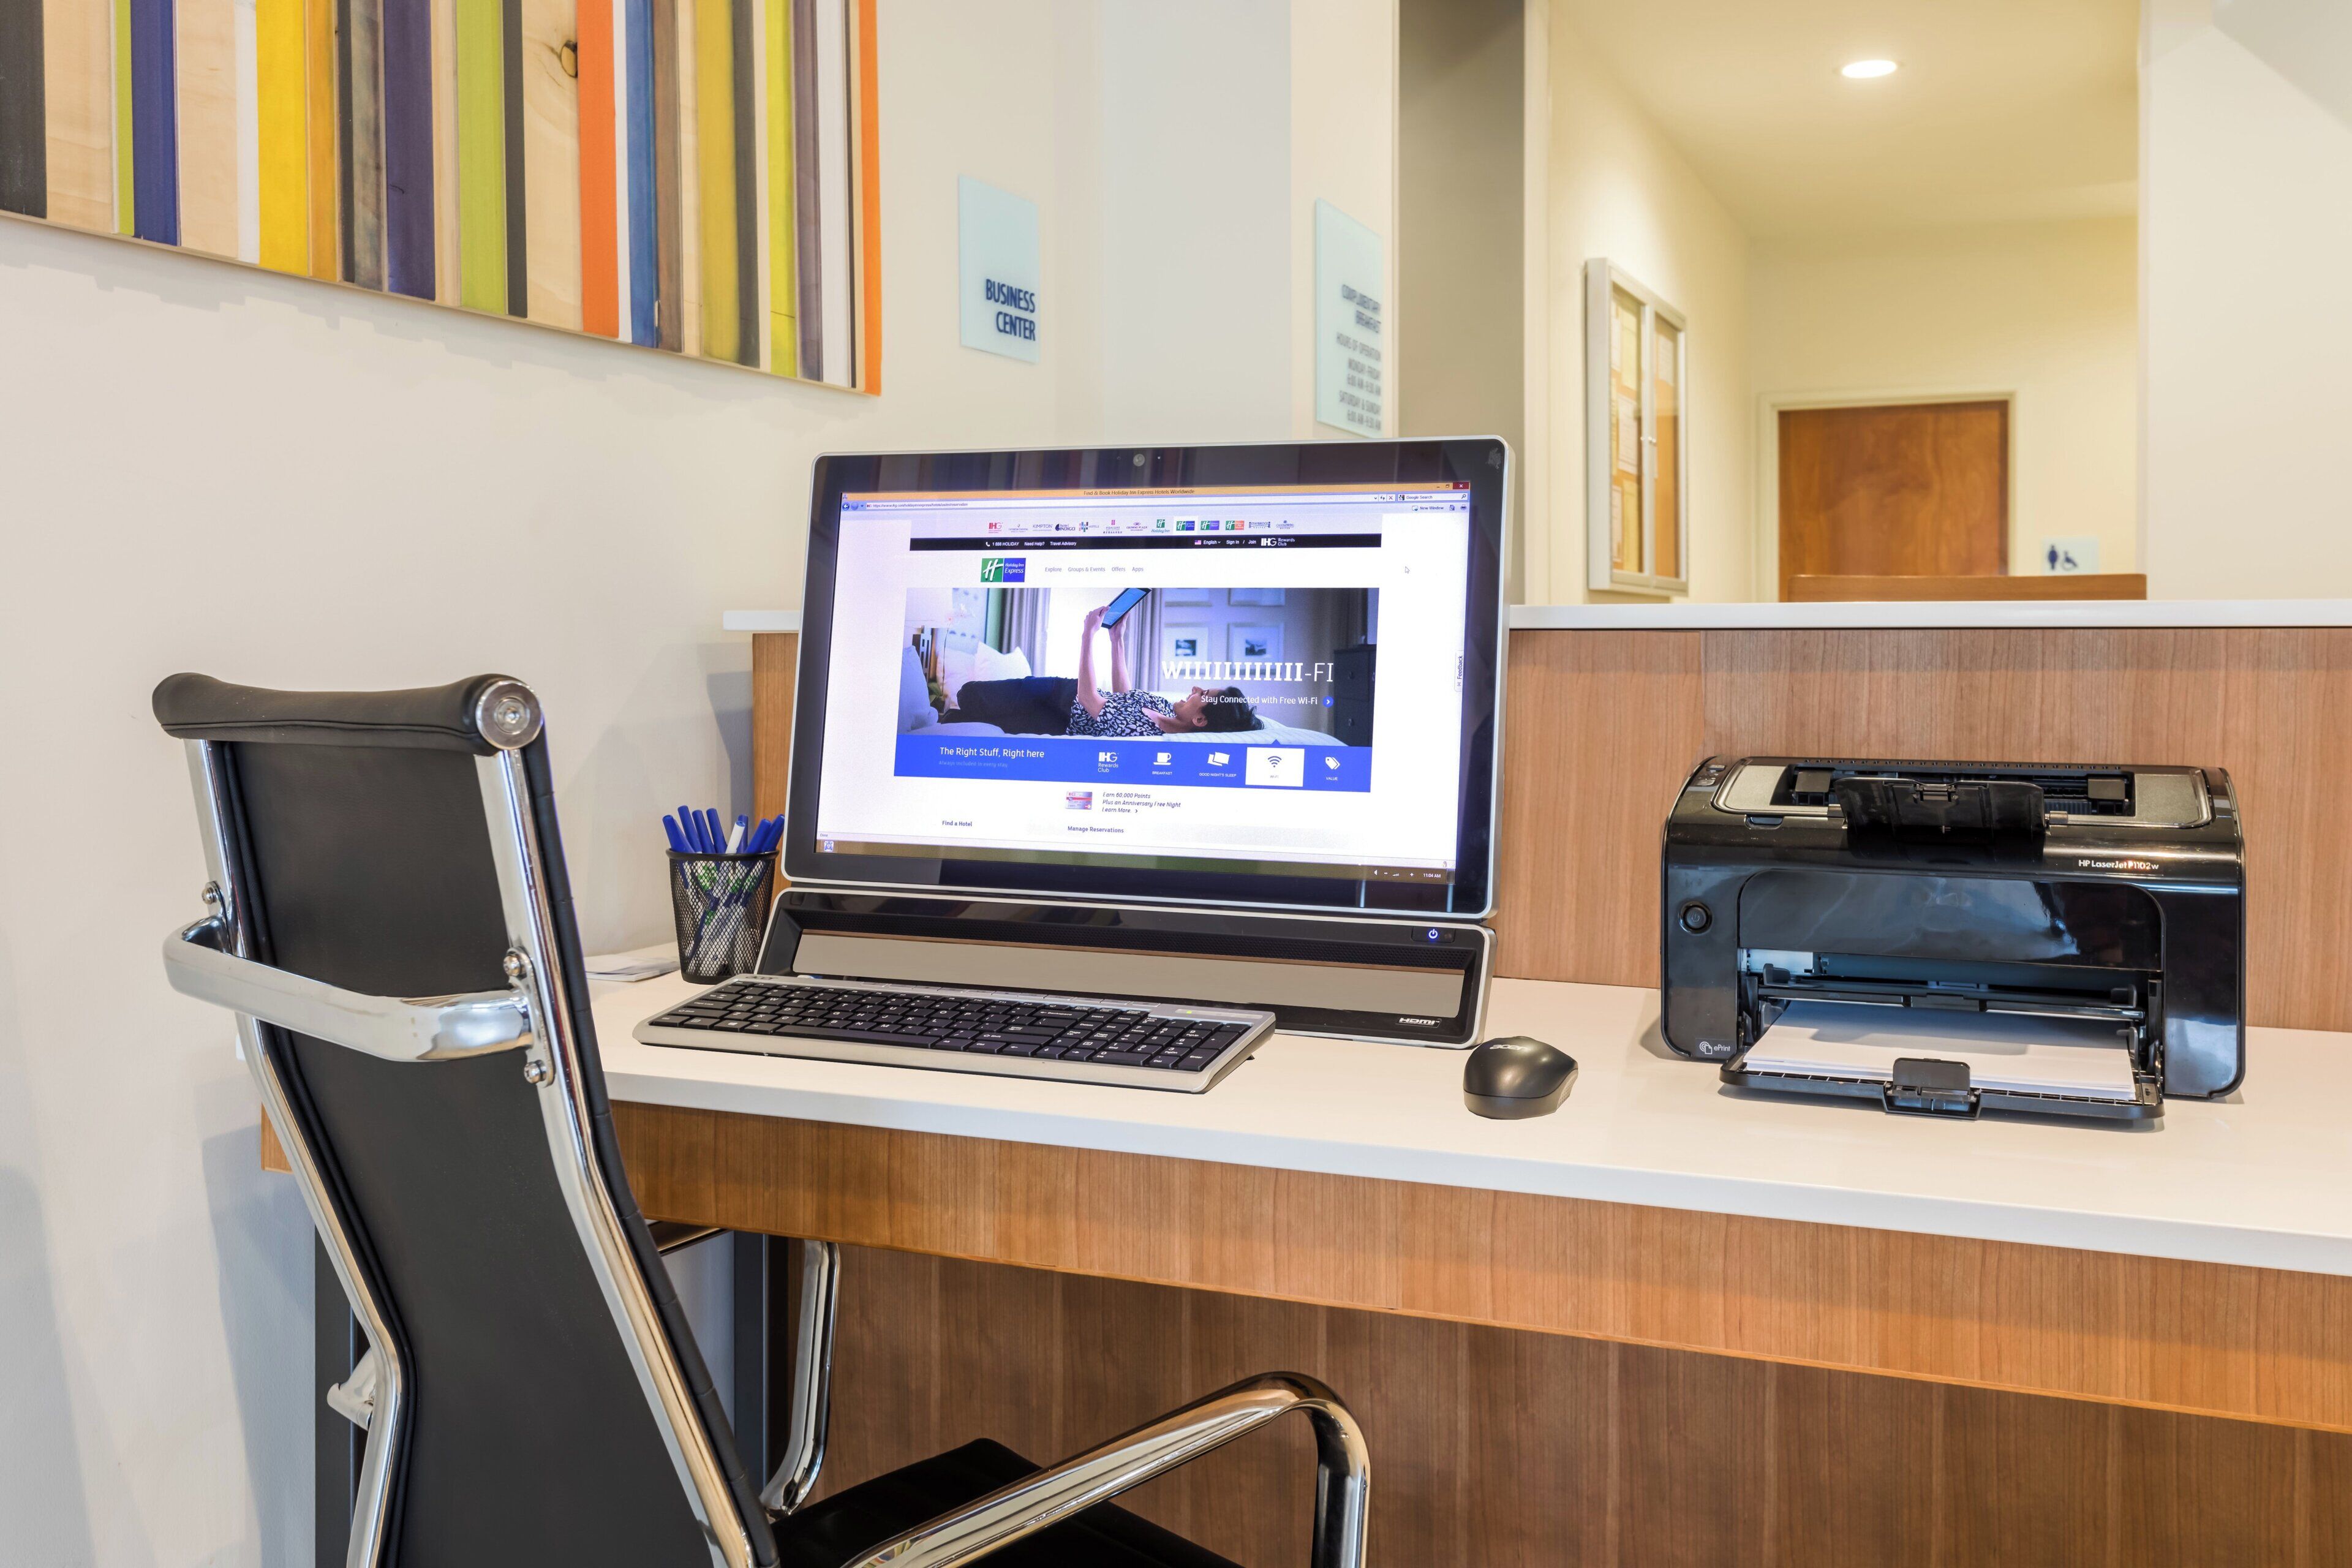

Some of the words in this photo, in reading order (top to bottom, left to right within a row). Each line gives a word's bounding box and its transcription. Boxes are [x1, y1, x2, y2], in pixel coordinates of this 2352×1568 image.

[986, 279, 1035, 314] BUSINESS
[996, 311, 1035, 341] CENTER
[1261, 538, 1277, 546] IHG
[1201, 695, 1218, 705] Stay
[1219, 696, 1261, 704] Connected
[940, 747, 954, 755] The
[956, 747, 977, 758] Right
[979, 748, 1000, 758] Stuff,
[1003, 749, 1025, 759] Right
[1098, 752, 1118, 762] IHG
[2091, 860, 2127, 869] LaserJet
[2128, 860, 2159, 870] P1102w
